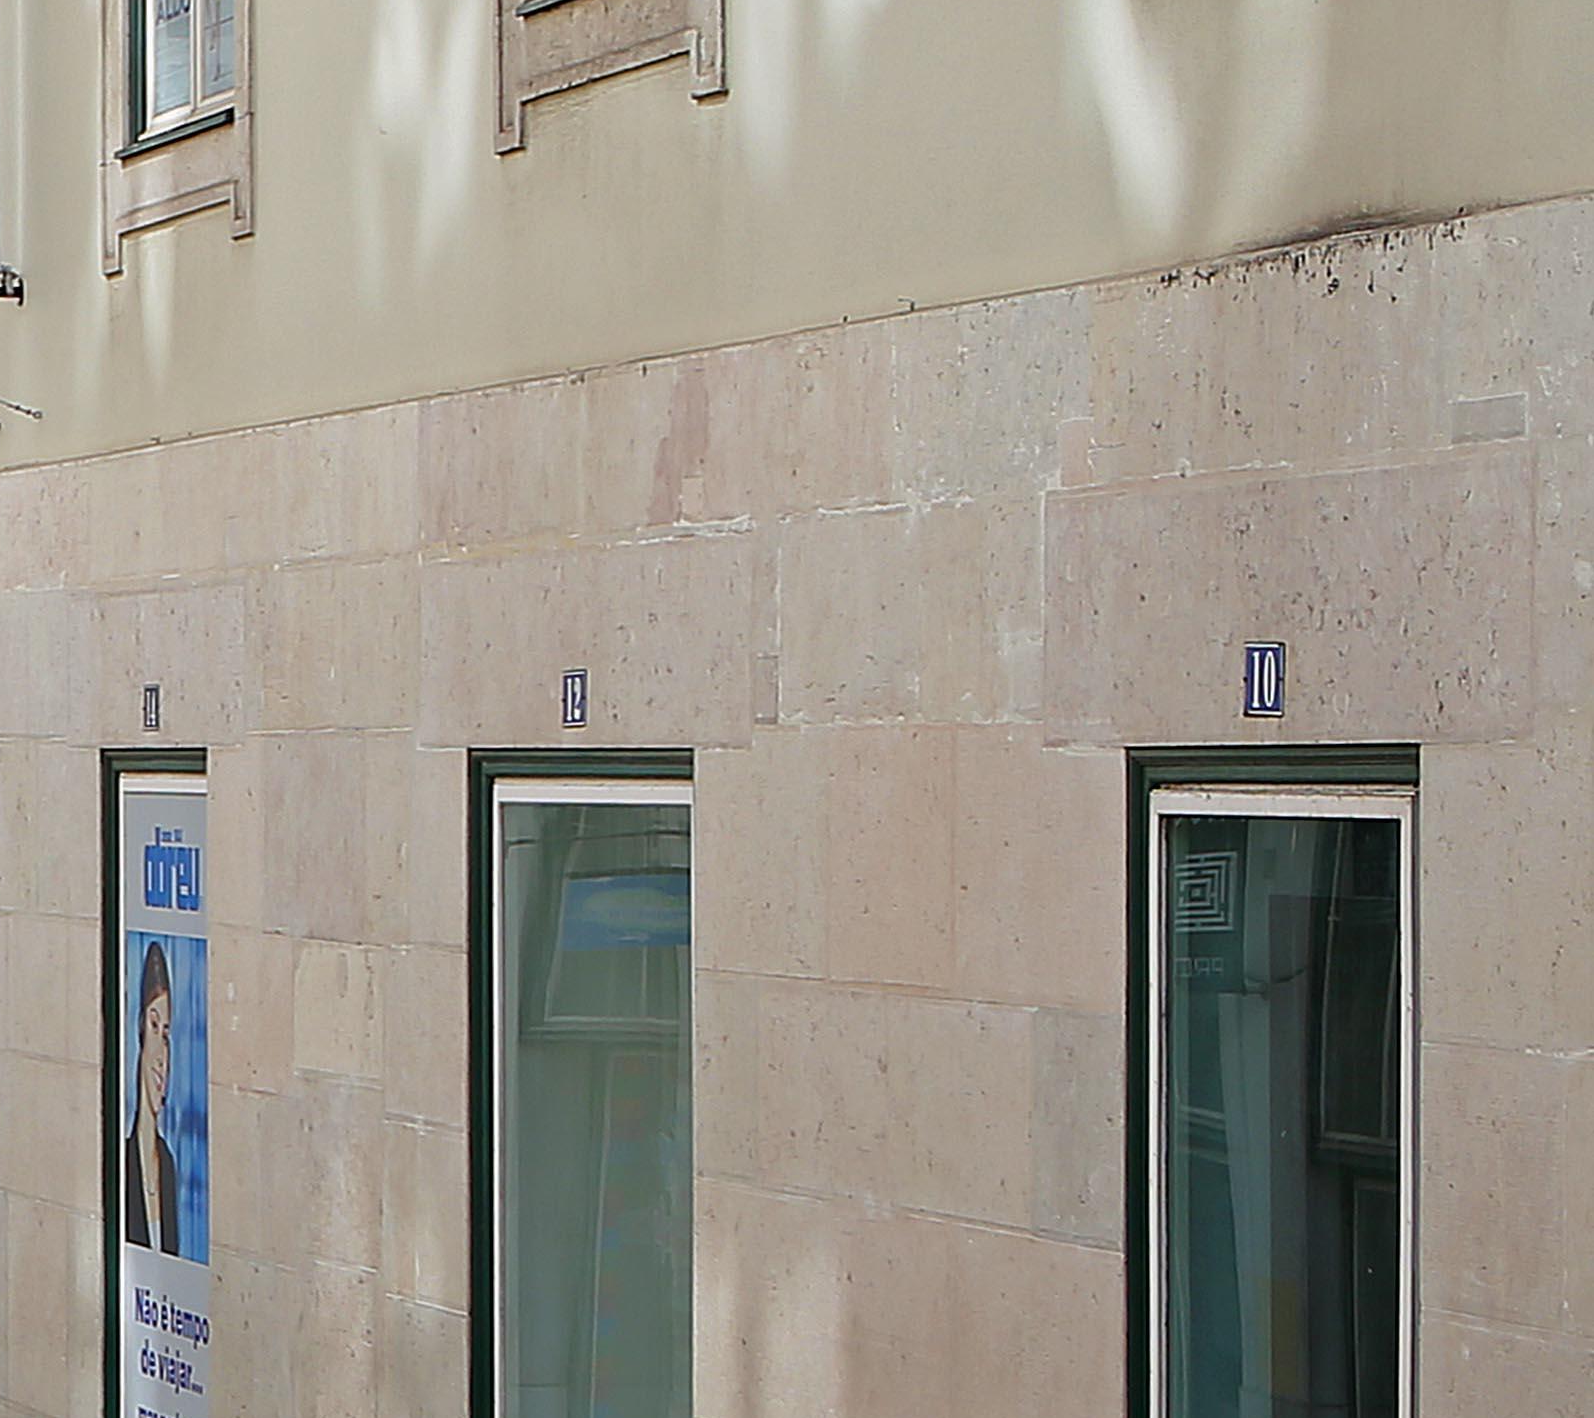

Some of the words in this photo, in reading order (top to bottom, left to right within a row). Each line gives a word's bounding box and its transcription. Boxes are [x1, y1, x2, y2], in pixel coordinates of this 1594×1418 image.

[565, 676, 582, 721] 12
[1252, 650, 1275, 709] 10
[135, 1287, 158, 1328] Não
[160, 1294, 168, 1331] é
[170, 1302, 209, 1350] tempo
[141, 1338, 157, 1377] de
